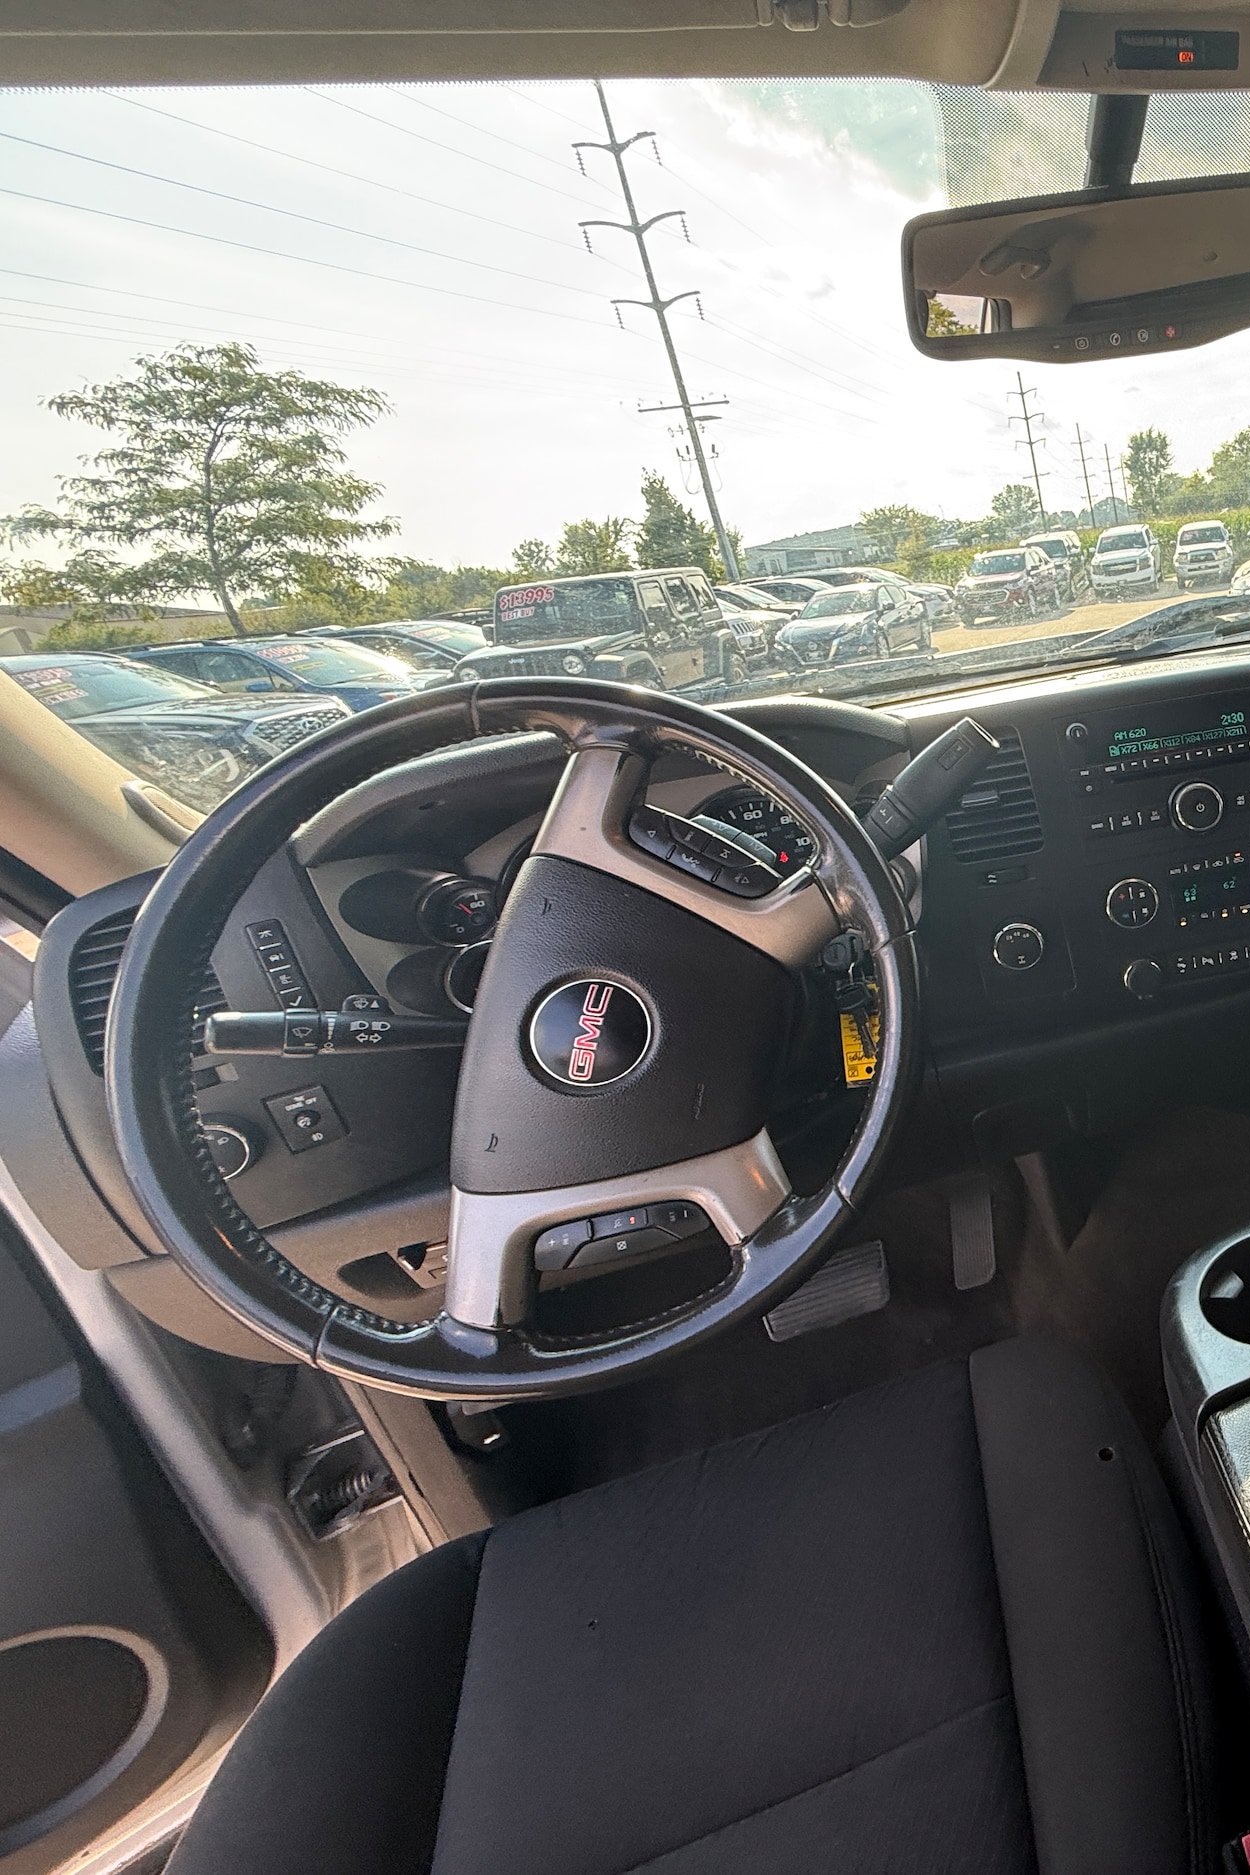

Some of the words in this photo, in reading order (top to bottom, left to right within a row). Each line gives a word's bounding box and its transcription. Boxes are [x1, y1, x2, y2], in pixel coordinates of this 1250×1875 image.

[500, 586, 554, 609] $13995
[502, 609, 519, 621] BEST
[1220, 712, 1245, 725] 2:30
[1114, 731, 1128, 741] AM
[1128, 727, 1147, 738] 620
[1121, 744, 1138, 754] X72
[1142, 741, 1159, 751] X66
[1226, 727, 1243, 737] X211
[743, 809, 763, 821] 60
[568, 983, 614, 1081] GMC
